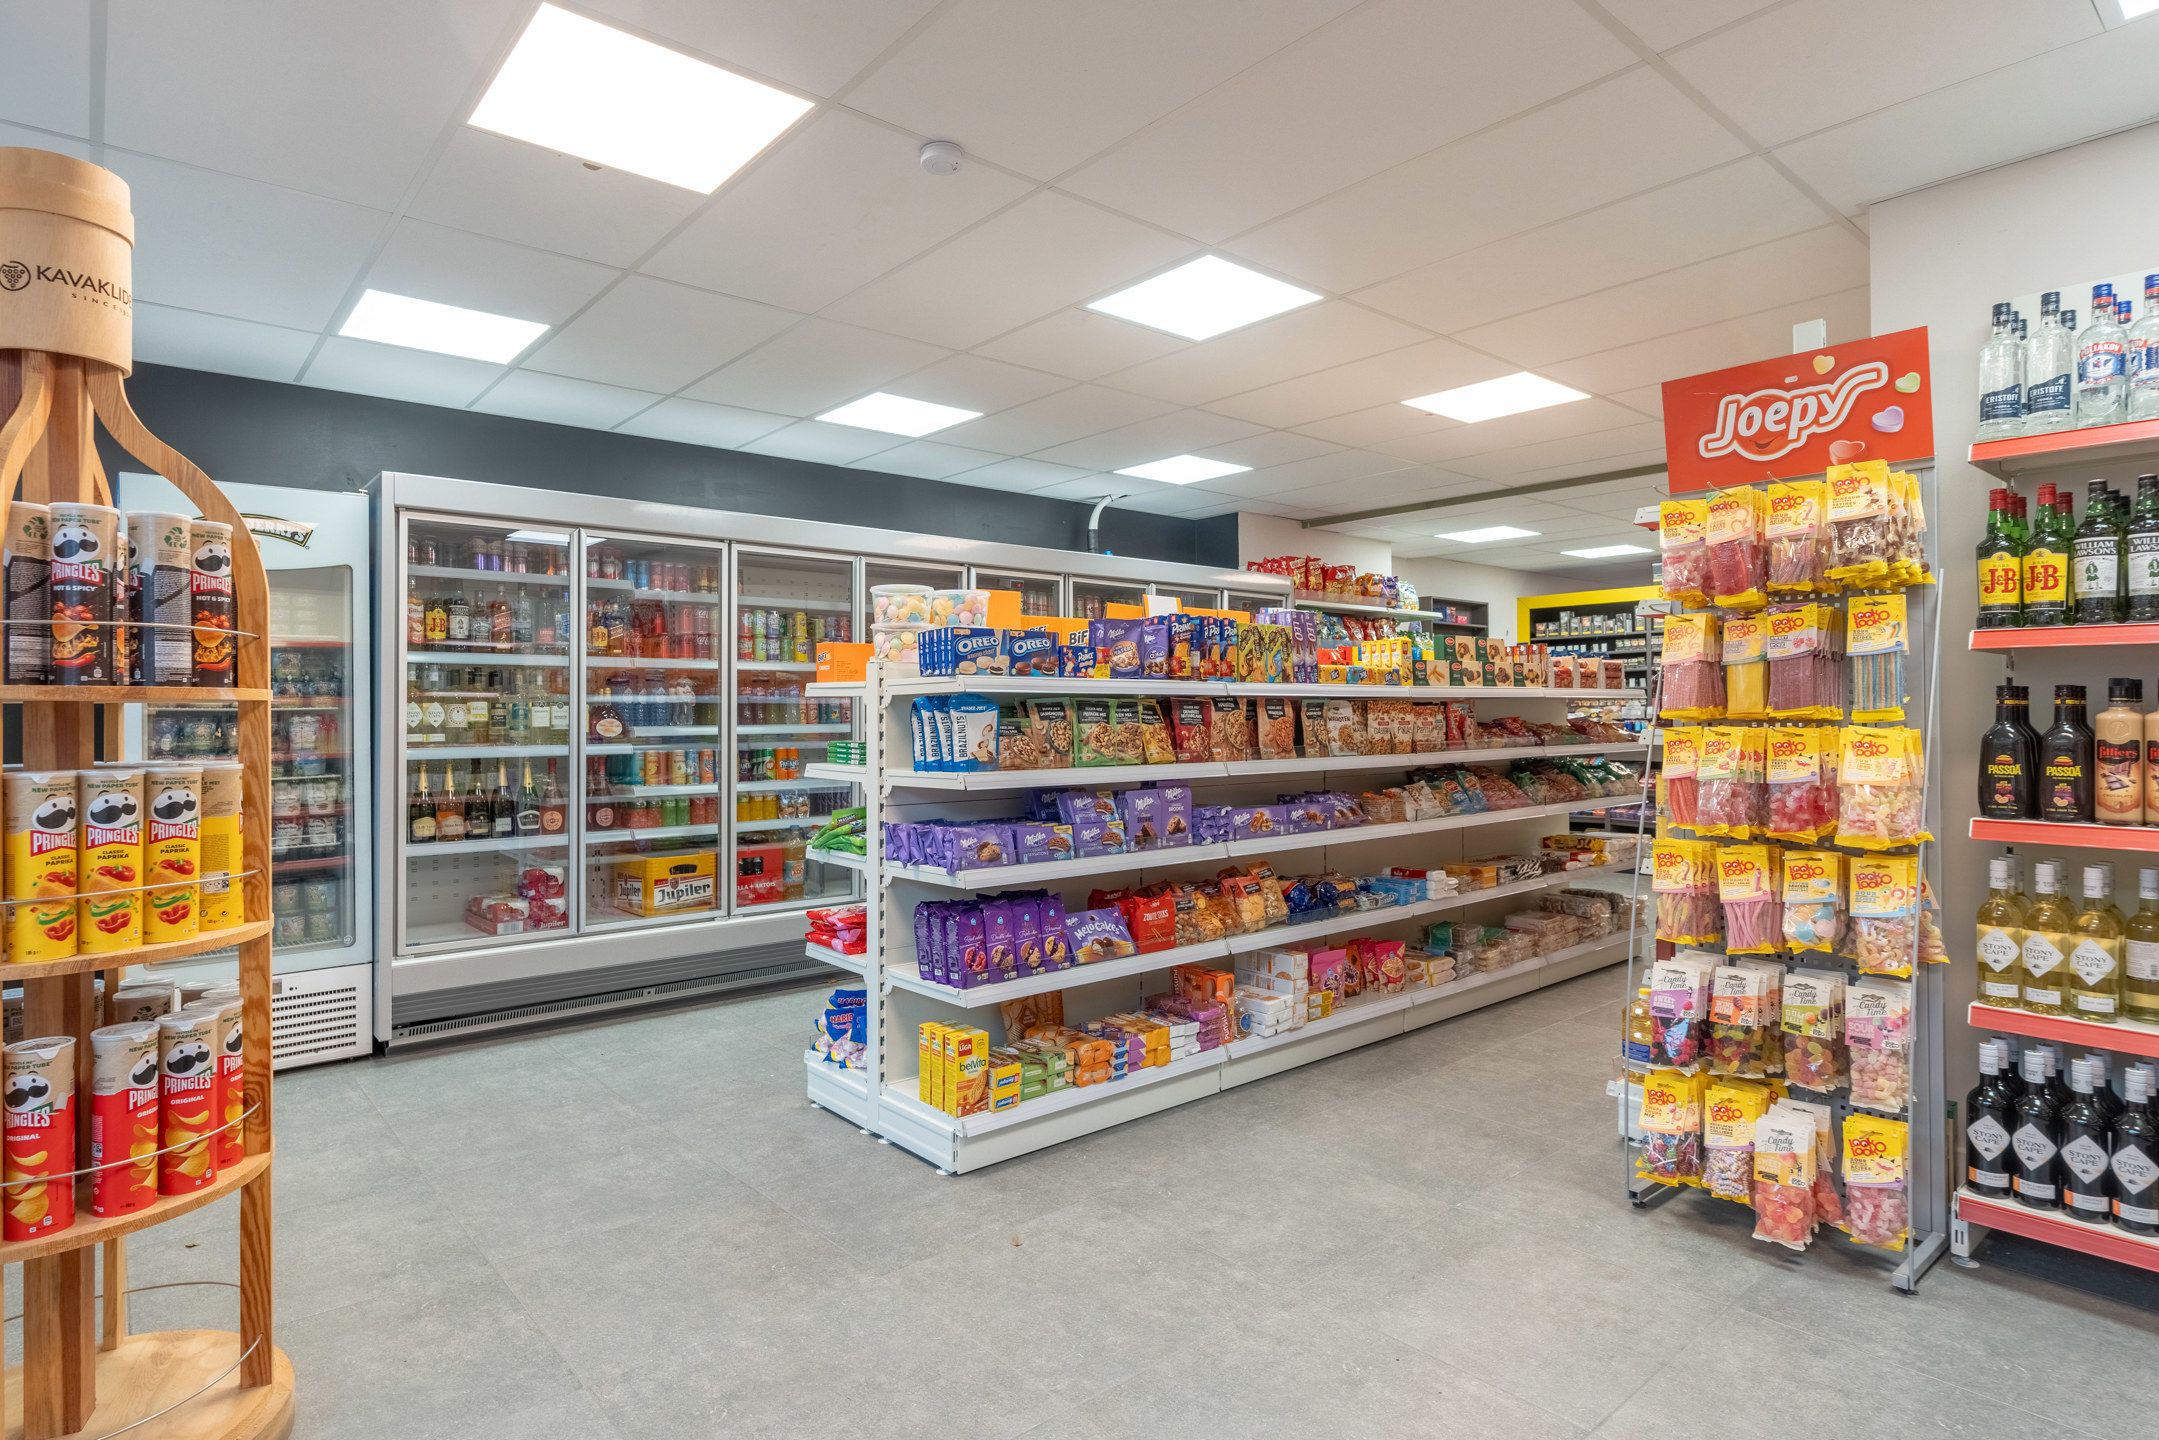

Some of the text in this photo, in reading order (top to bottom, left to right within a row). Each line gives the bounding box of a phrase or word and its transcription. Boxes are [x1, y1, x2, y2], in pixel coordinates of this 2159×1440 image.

[2029, 385, 2064, 397] ERISTOFF
[1985, 393, 2019, 404] ERISTOFF
[1704, 369, 1880, 450] Joepy
[2075, 541, 2114, 550] WILLIAM
[2133, 537, 2159, 545] WILLI
[51, 561, 101, 583] PRINGLES
[1984, 567, 2017, 594] J&B
[2025, 564, 2060, 592] J&B
[1292, 621, 1304, 641] LEO
[1306, 621, 1317, 642] LEO
[1069, 629, 1089, 646] BiF
[958, 637, 999, 653] OREO
[1013, 638, 1051, 654] OREO
[928, 716, 940, 758] BRAZILNUTS
[957, 715, 968, 758] BRAZILNUTS
[1165, 787, 1183, 800] Milka
[1074, 796, 1093, 808] Milka
[1135, 797, 1154, 811] Milka
[1233, 813, 1251, 826] Milka
[87, 825, 138, 847] PRINGLES
[151, 819, 197, 842] PRINGLES
[1080, 827, 1101, 841] Milka
[33, 831, 76, 854] PRINGLE
[961, 837, 978, 848] Milka
[1024, 832, 1047, 846] Milka
[160, 847, 190, 855] PAPRIKA
[97, 853, 130, 861] PAPRIKA
[619, 881, 641, 897] Jupiler
[755, 881, 776, 889] ARTOIS
[658, 882, 711, 903] Jupiler
[540, 920, 566, 930] Jupiler
[1982, 942, 2013, 951] STONY
[2024, 947, 2055, 957] STONY
[1984, 948, 2009, 957] CAPE
[2025, 953, 2050, 962] CAPE
[2074, 954, 2108, 964] STONY
[2076, 960, 2103, 969] CAPE
[1663, 975, 1688, 983] Candy
[1724, 981, 1748, 989] Candy
[1792, 989, 1818, 999] Candy
[1858, 1000, 1887, 1010] Candy
[959, 1056, 987, 1073] belVita
[164, 1070, 212, 1096] PRINGLES
[170, 1094, 205, 1105] ORIGINAL
[5, 1105, 51, 1129] RINGLES
[1973, 1129, 2003, 1140] STONY
[1767, 1136, 1795, 1146] Candy
[1974, 1136, 2000, 1146] CAPE
[2015, 1138, 2047, 1149] STONY
[2017, 1144, 2044, 1155] CAPE
[2068, 1150, 2101, 1161] STONY
[2070, 1156, 2099, 1167] CAPE
[2116, 1159, 2150, 1171] STONY
[2118, 1167, 2147, 1178] CAPE
